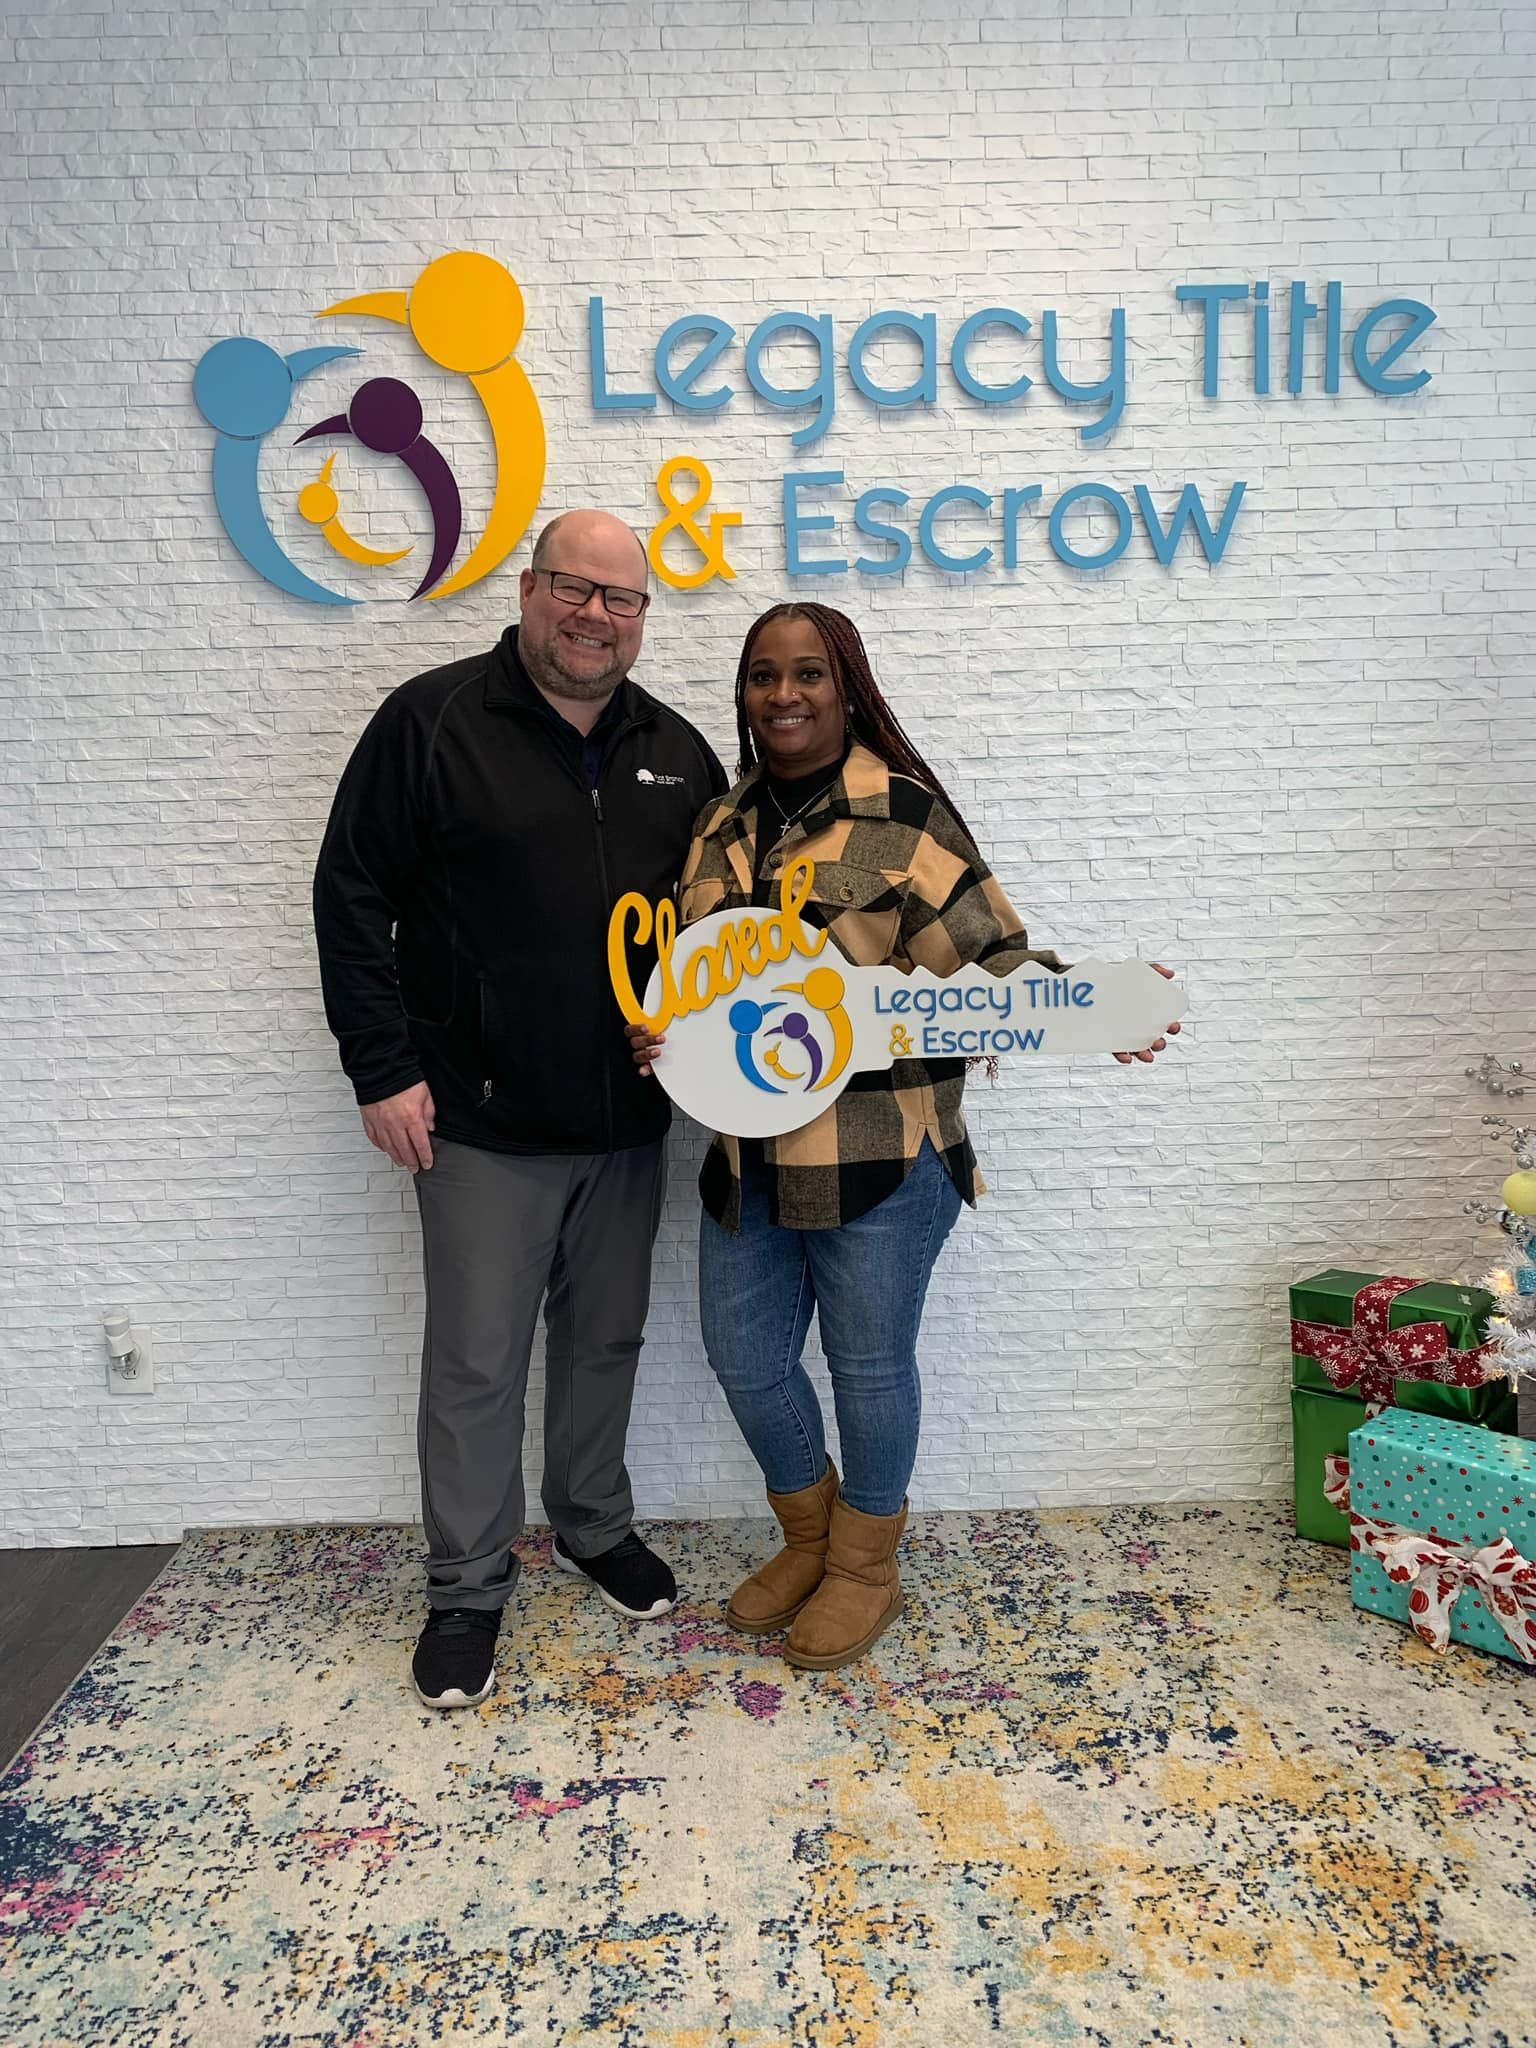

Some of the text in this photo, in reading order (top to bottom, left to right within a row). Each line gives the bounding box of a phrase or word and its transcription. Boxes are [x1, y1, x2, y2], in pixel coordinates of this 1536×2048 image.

[589, 280, 1438, 445] Legacy Title
[648, 456, 1247, 590] & Escrow
[607, 856, 829, 1036] Closed
[873, 977, 1095, 1021] Legacy Title
[888, 1023, 1046, 1058] & Escrow
